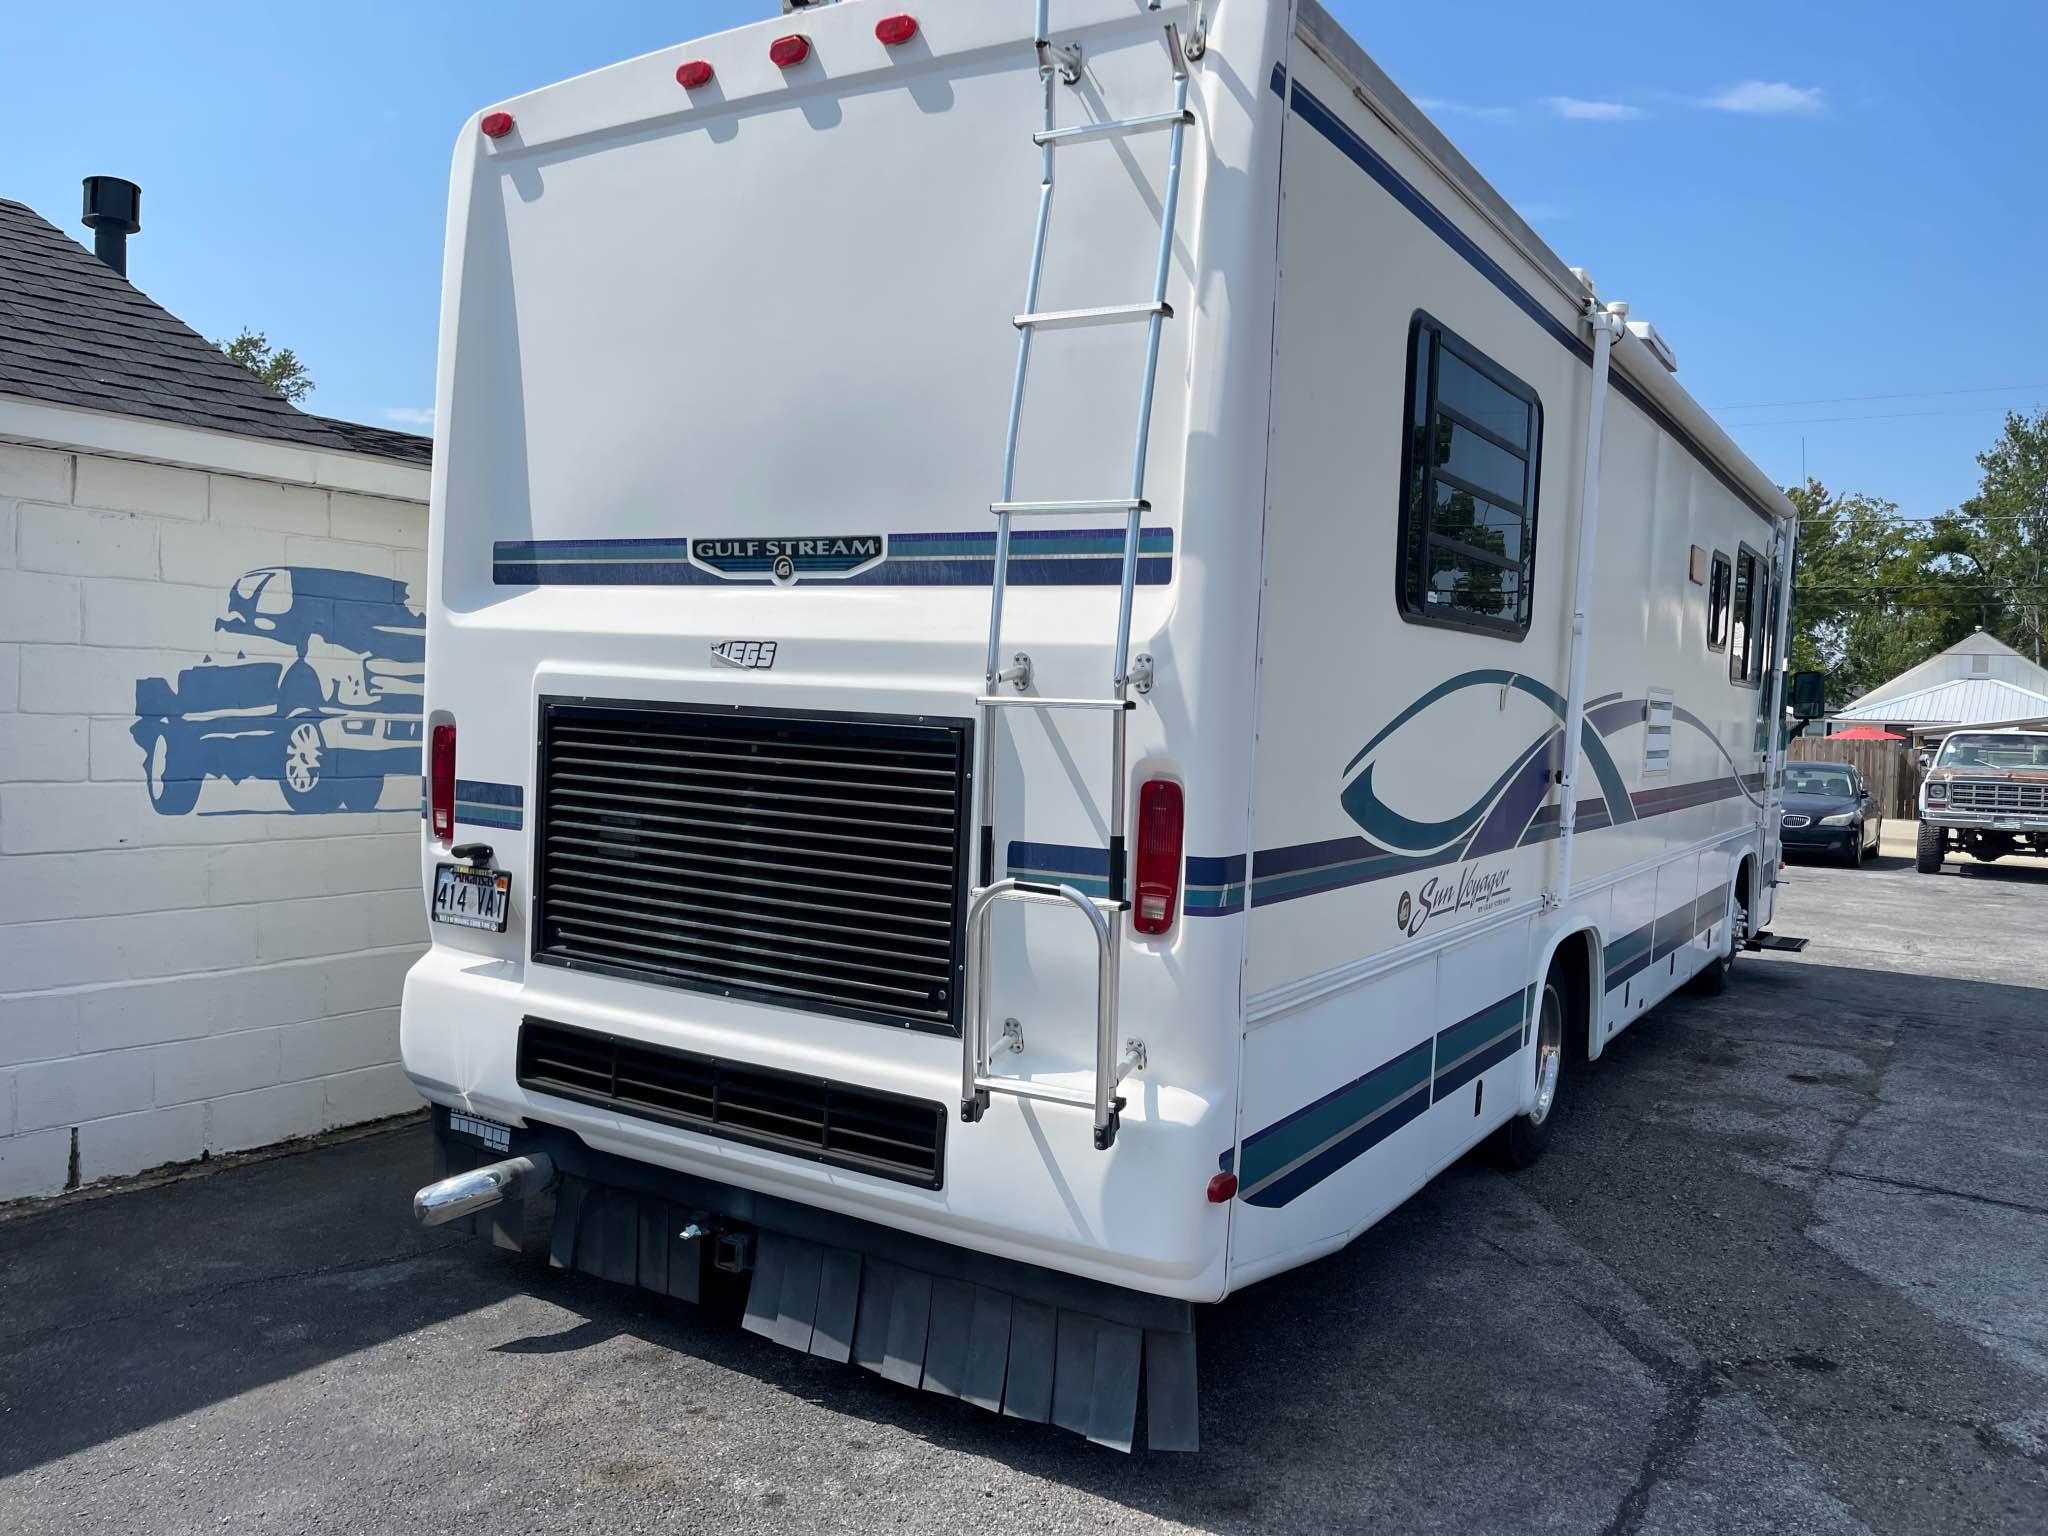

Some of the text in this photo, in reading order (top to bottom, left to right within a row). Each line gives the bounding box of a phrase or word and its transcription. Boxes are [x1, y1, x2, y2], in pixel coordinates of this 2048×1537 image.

[696, 539, 877, 557] GULF STREAM
[438, 882, 467, 912] 414
[478, 887, 505, 919] VAT
[1407, 862, 1510, 938] Sun Voyager
